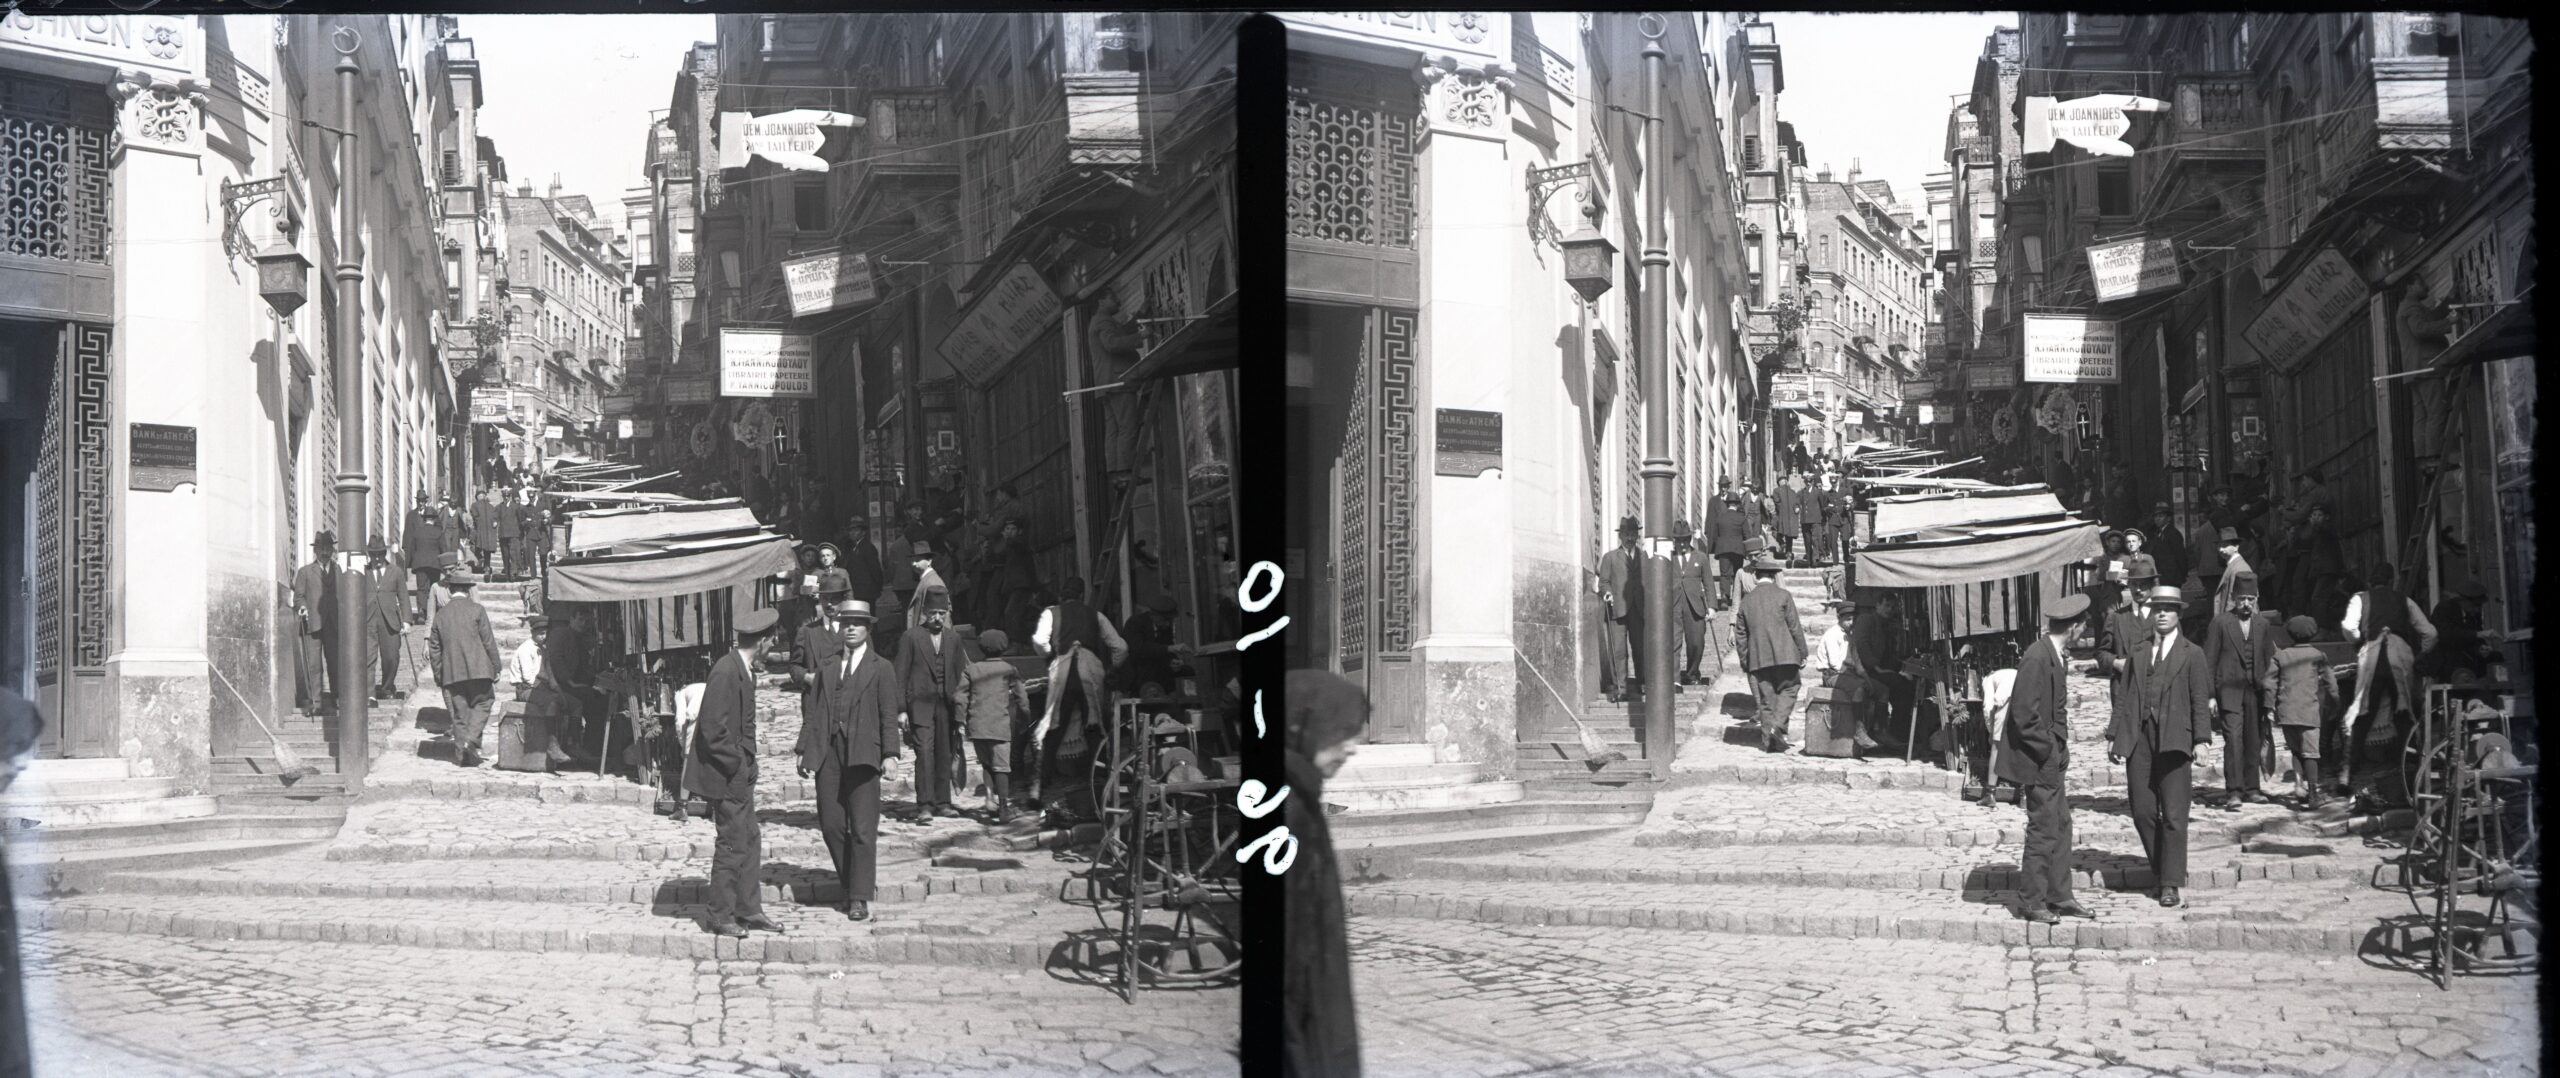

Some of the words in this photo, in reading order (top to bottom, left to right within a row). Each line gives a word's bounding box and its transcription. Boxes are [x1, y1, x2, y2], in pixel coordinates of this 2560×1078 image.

[2069, 106, 2121, 120] JOANNIDES
[765, 122, 816, 136] JOANNIDES
[2072, 125, 2120, 136] TAILLEUR
[768, 140, 815, 152] TAILLEUR
[2073, 357, 2114, 366] PAPETERIE
[770, 371, 810, 380] PAPETERIE
[1782, 390, 1798, 401] 70
[481, 405, 497, 415] 70
[1438, 414, 1462, 424] BANK
[1469, 416, 1501, 427] ATHENS
[132, 429, 155, 439] BANK
[163, 431, 195, 442] ATHENS
